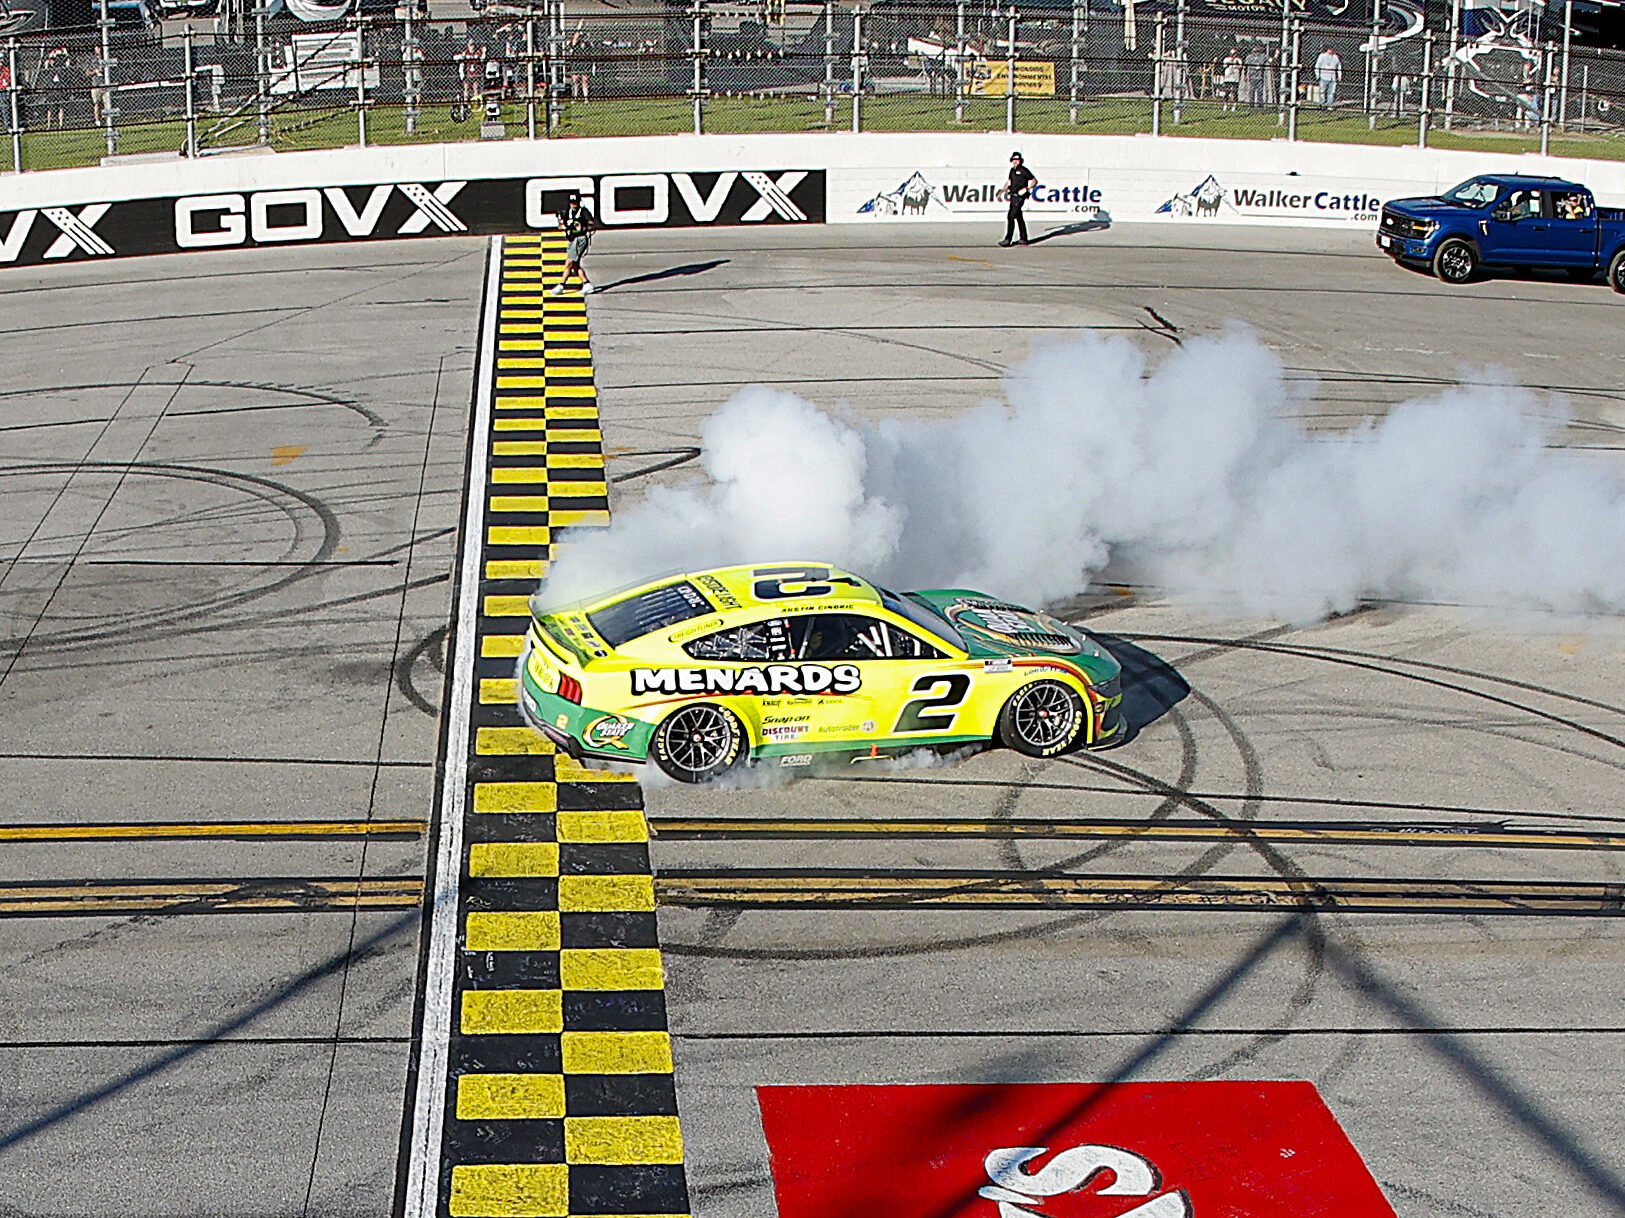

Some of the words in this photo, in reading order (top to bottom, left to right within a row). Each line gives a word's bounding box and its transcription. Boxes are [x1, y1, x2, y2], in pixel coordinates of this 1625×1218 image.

[175, 181, 468, 249] GOVX
[525, 171, 809, 228] GOVX
[631, 664, 862, 695] MENARDS
[894, 673, 972, 733] 2
[761, 725, 809, 736] DISCOUNT
[1041, 710, 1083, 756] GOODYEAR
[780, 754, 813, 764] FORD
